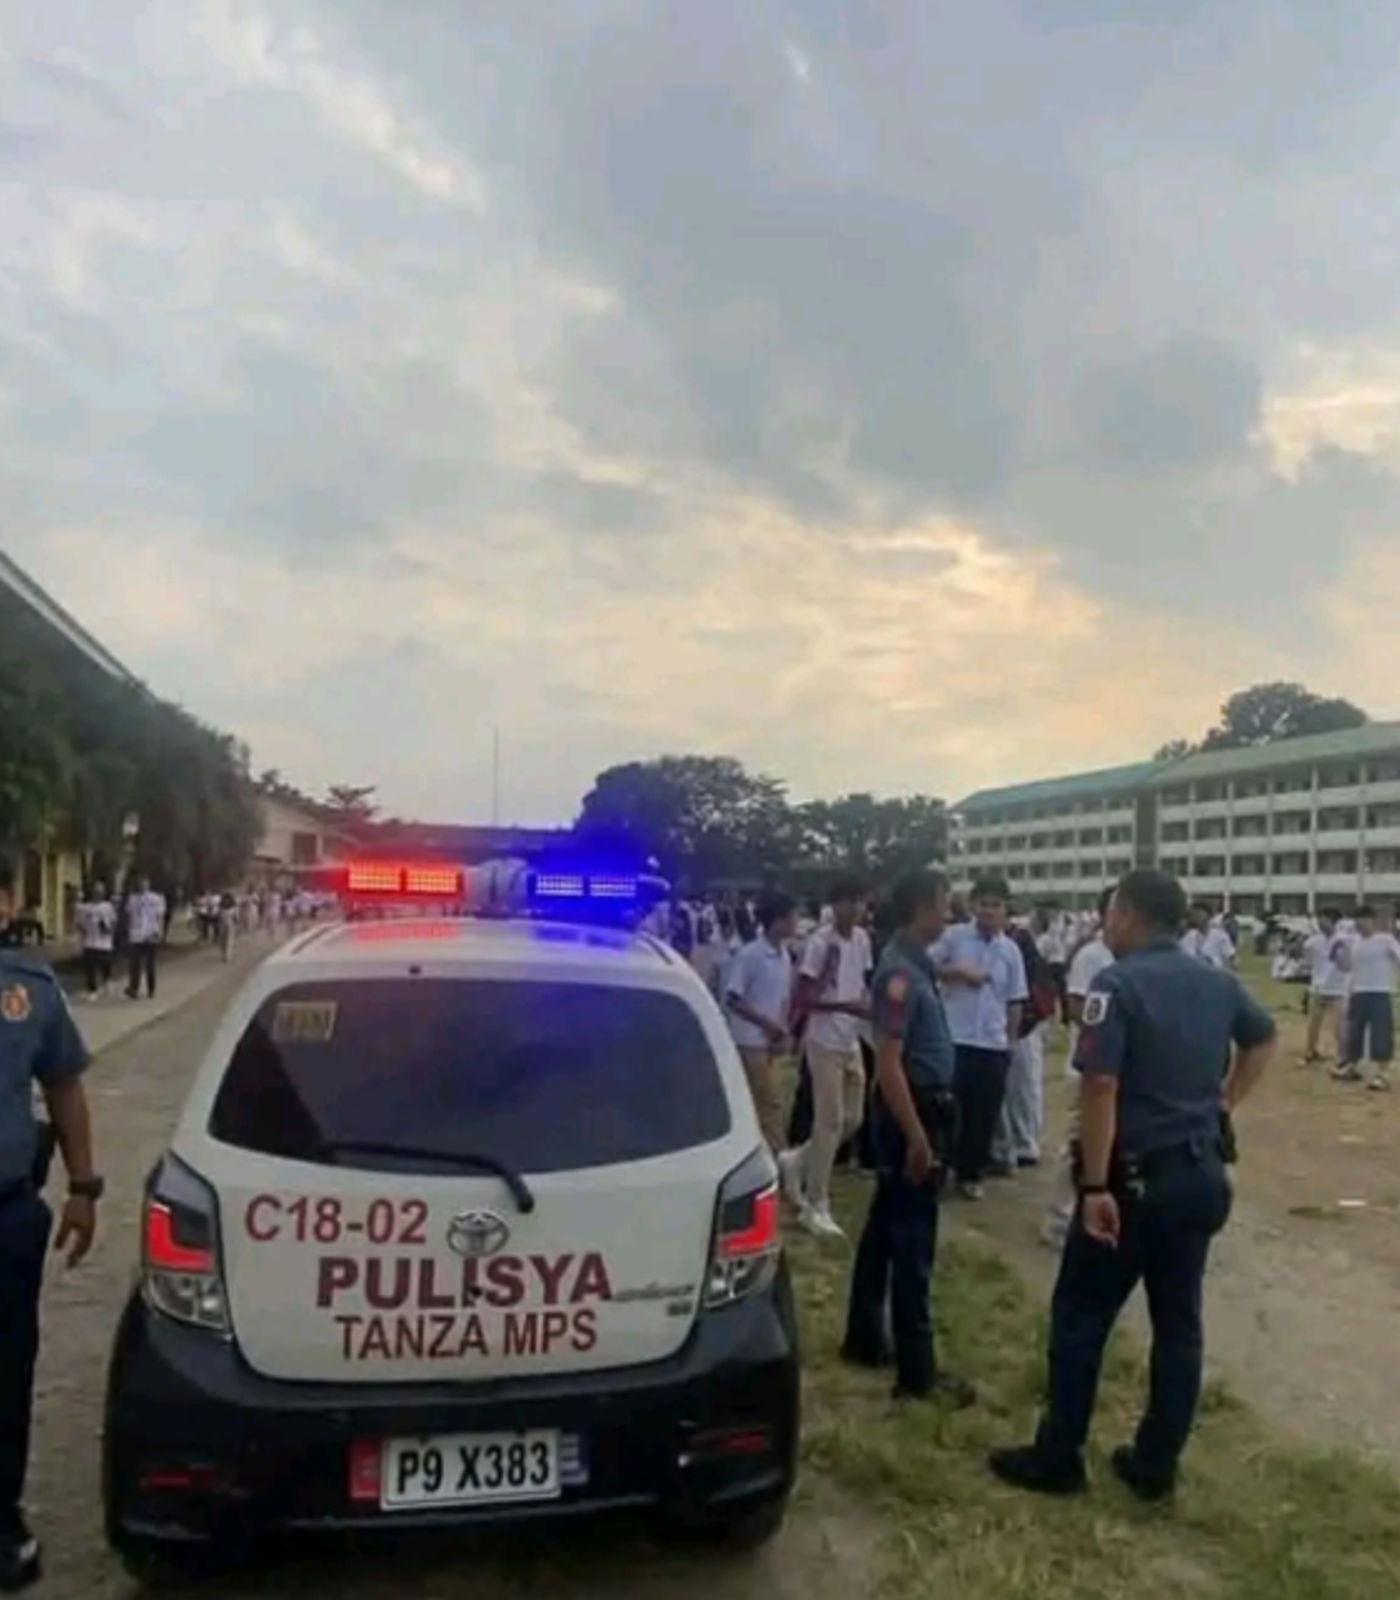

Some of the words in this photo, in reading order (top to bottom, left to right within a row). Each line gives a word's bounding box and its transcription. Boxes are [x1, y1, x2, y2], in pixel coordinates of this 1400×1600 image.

[245, 1195, 428, 1243] C18-02
[317, 1252, 612, 1309] PULISYA
[335, 1315, 489, 1360] TANZA
[504, 1309, 597, 1356] MPS
[397, 1449, 444, 1494] P9
[457, 1441, 550, 1491] X383
